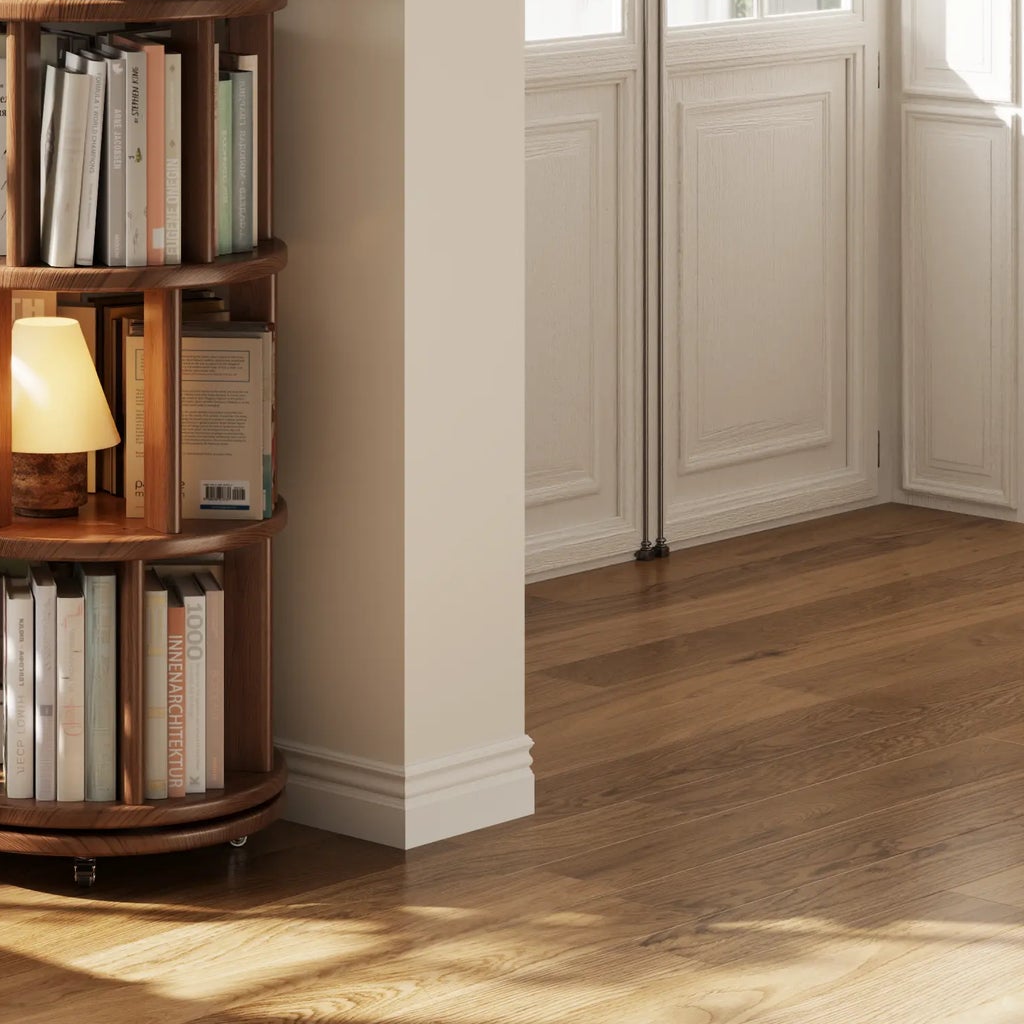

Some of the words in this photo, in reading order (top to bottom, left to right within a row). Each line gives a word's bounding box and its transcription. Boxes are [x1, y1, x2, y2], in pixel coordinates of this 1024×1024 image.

[94, 72, 103, 104] FORMULA
[131, 67, 139, 85] KING
[113, 109, 121, 129] ARNE
[131, 87, 139, 116] STEPHEN
[91, 110, 99, 135] WORLD
[112, 131, 121, 170] JACOBSEN
[166, 158, 178, 205] ONEGIN
[166, 207, 178, 256] EUGENE
[187, 602, 203, 661] 1000
[168, 634, 183, 788] INNENARCHITEKTUR
